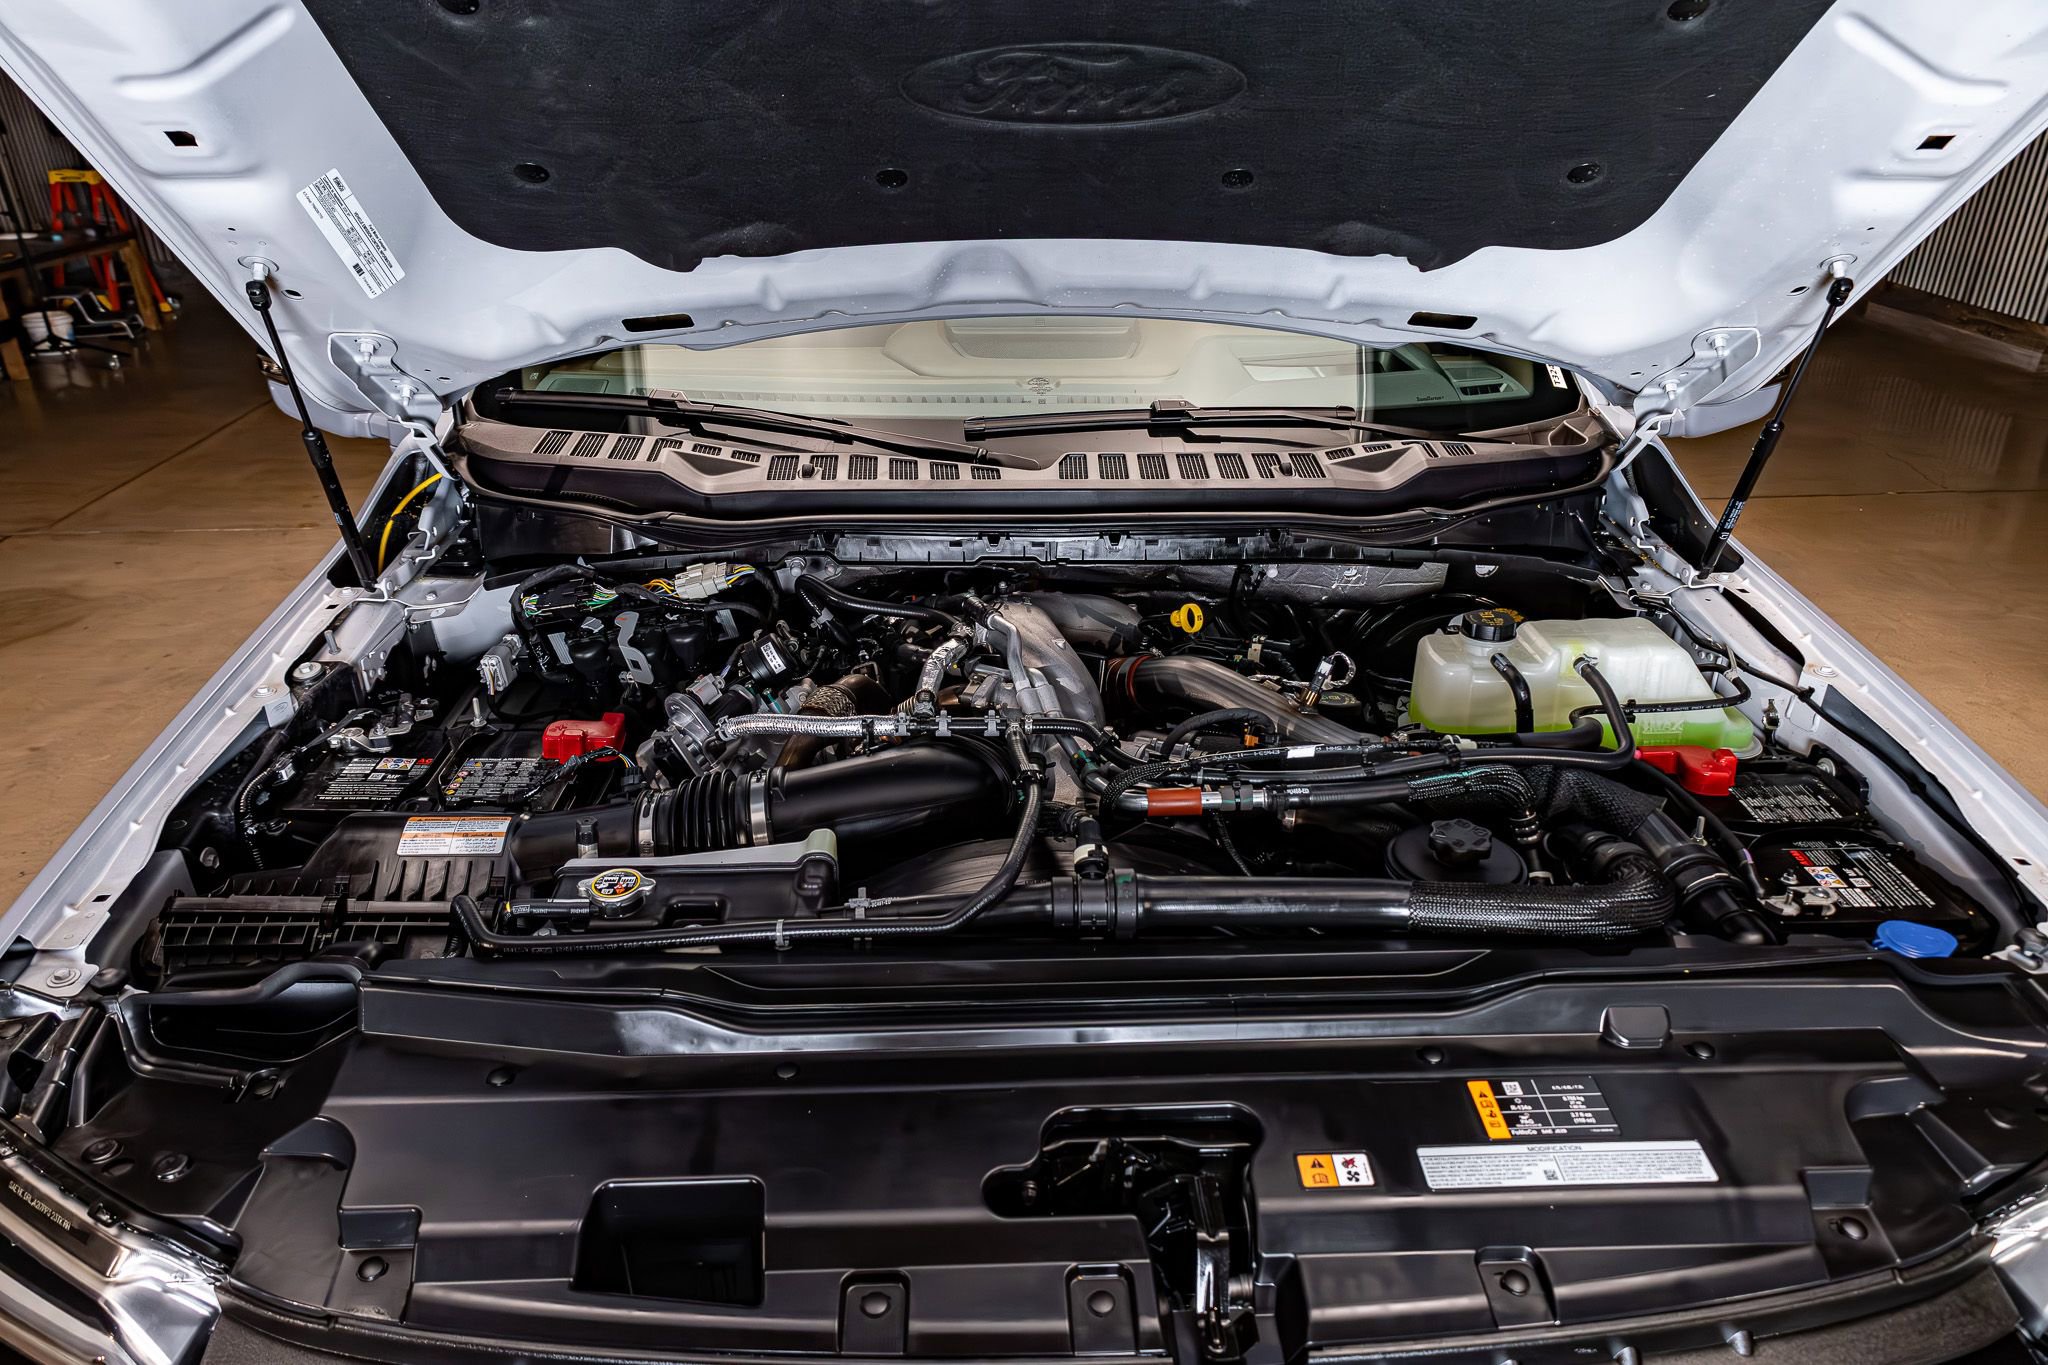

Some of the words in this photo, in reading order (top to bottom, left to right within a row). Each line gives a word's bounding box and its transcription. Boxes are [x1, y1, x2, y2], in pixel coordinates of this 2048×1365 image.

[957, 51, 1182, 115] Ford
[370, 237, 381, 250] CONTROL
[377, 238, 387, 251] Company
